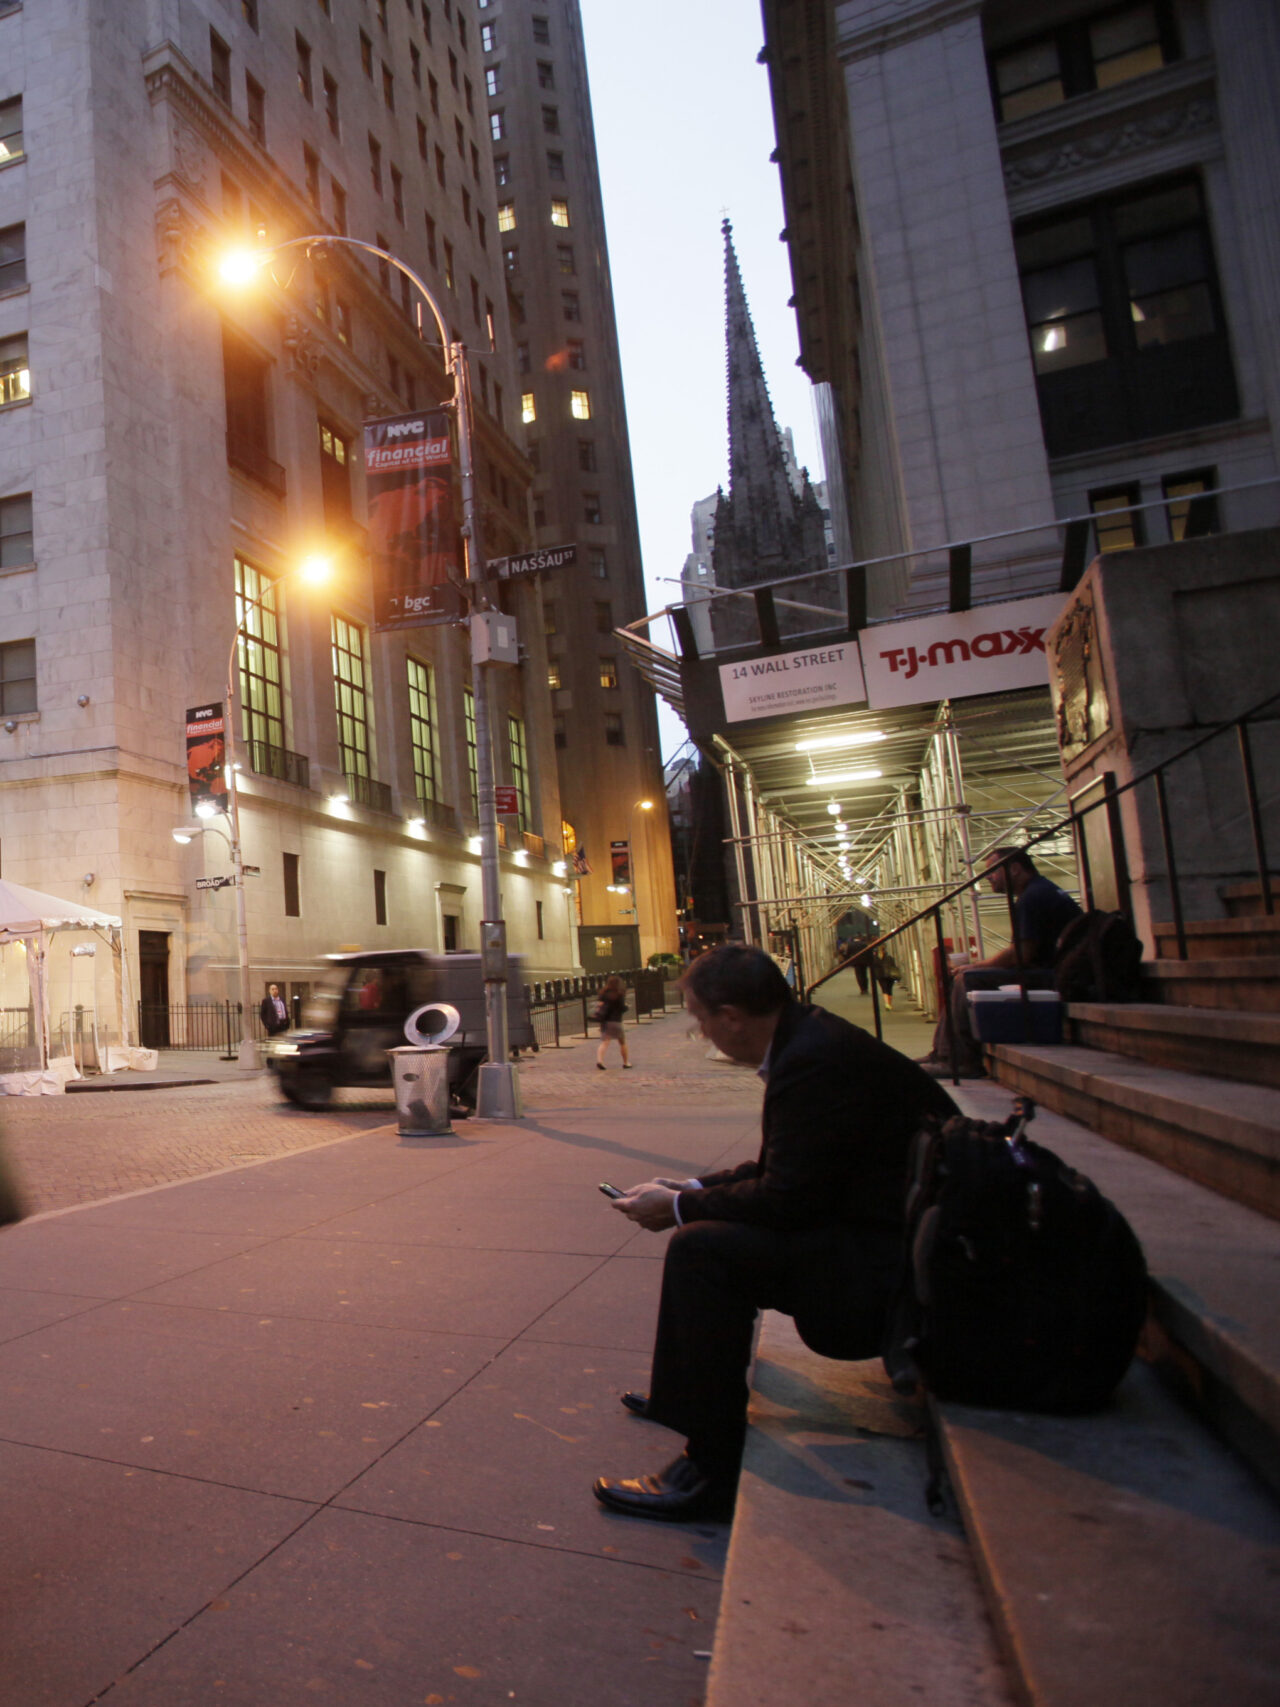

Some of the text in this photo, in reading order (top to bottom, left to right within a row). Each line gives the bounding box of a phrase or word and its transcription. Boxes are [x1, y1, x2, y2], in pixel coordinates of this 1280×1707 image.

[387, 421, 424, 438] NYC
[367, 439, 448, 467] financial
[511, 552, 564, 574] NASSAU
[564, 550, 574, 560] ST
[404, 595, 431, 612] bgc
[732, 648, 845, 680] 14 WALL STREET
[777, 685, 823, 699] RESTORATION
[196, 880, 220, 889] BROAD
